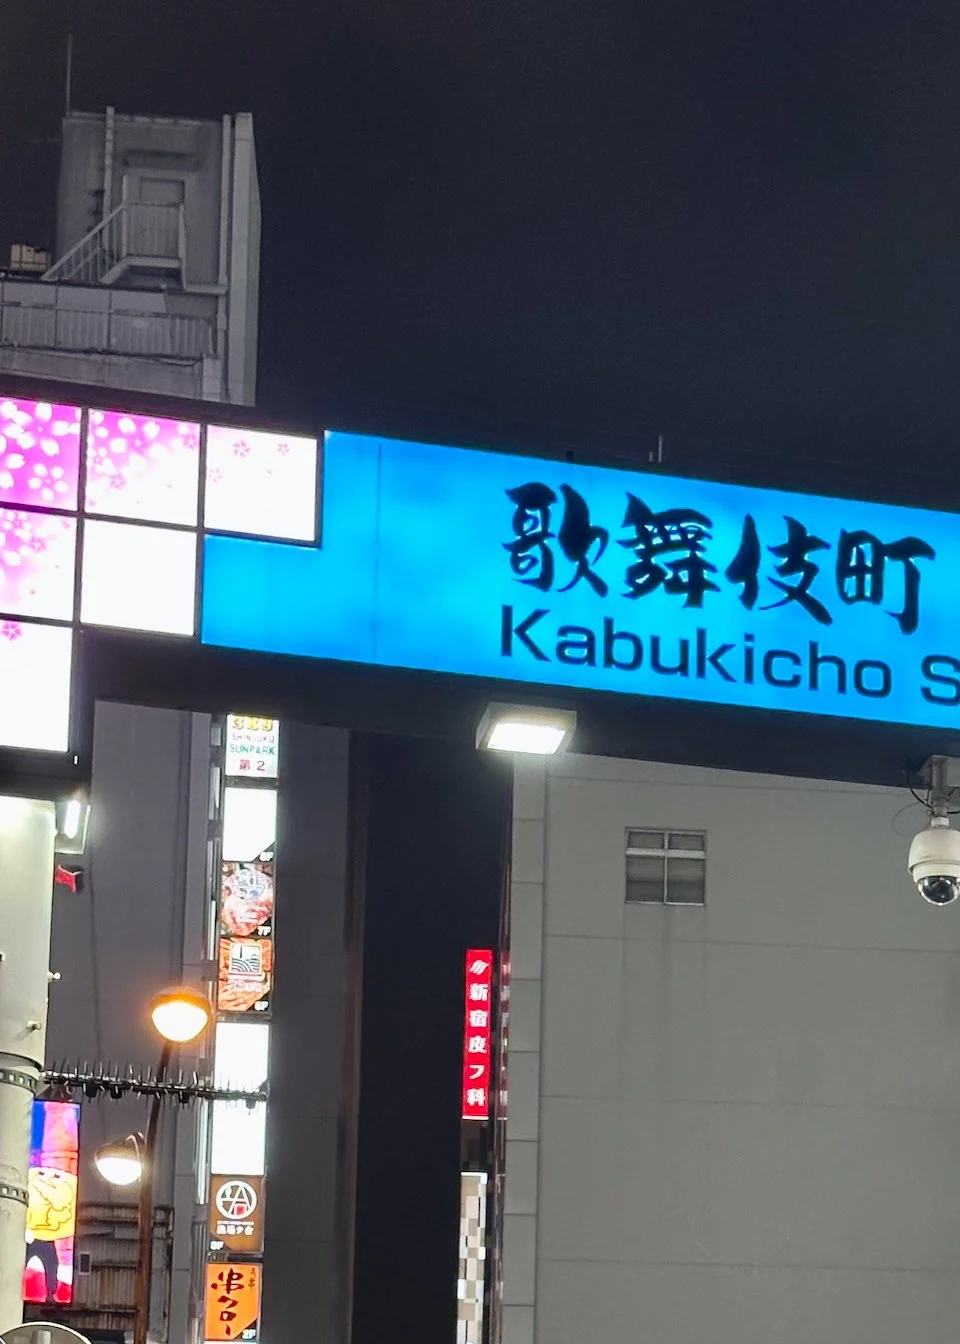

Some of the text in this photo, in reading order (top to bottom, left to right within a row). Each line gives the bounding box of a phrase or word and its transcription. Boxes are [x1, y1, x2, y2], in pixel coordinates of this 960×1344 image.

[502, 481, 936, 635] 歌舞伎町
[501, 604, 892, 698] Kabukicho
[230, 744, 276, 755] SUNPARK
[466, 983, 488, 1107] 新宿皮フ科
